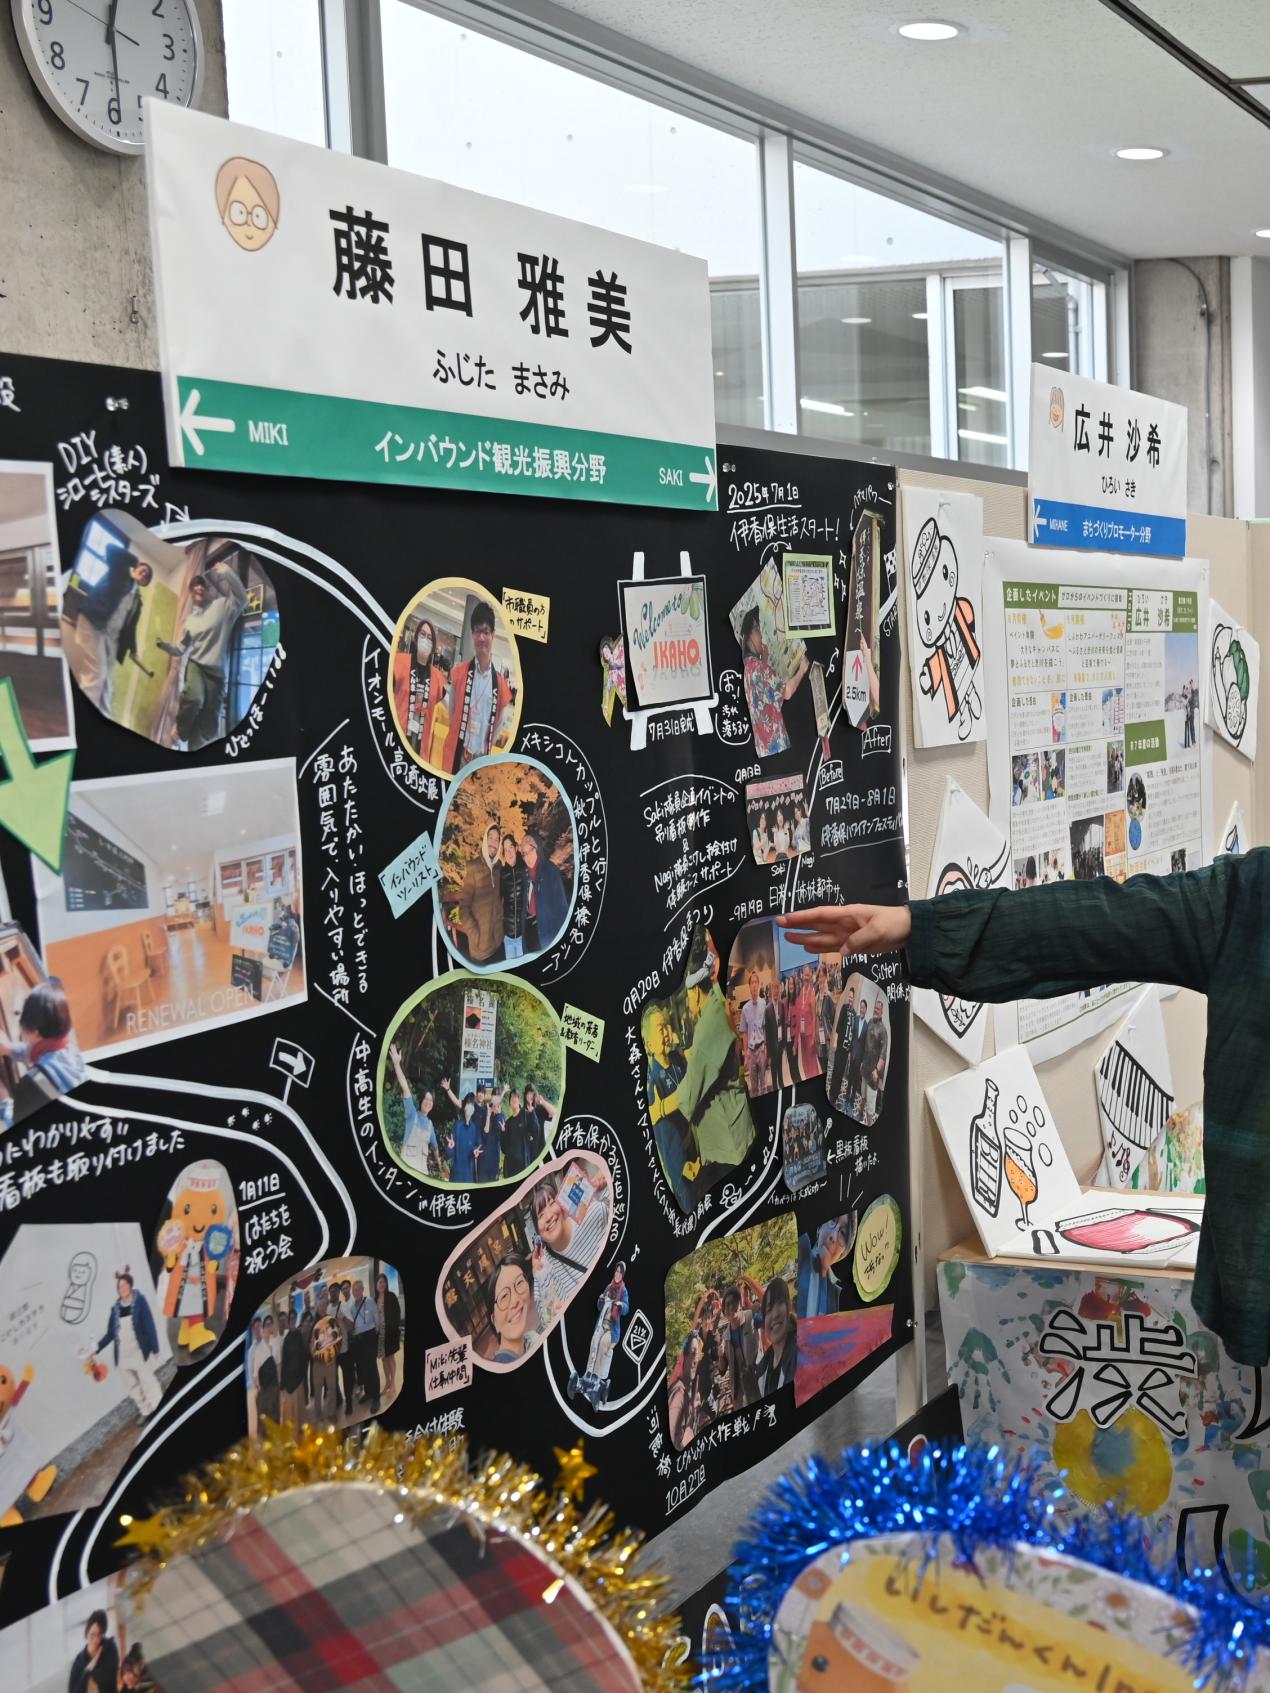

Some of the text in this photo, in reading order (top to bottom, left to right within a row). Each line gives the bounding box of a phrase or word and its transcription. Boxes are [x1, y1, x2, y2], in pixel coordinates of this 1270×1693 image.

[50, 41, 65, 70] 8
[162, 34, 175, 61] 3
[76, 78, 89, 105] 7
[155, 72, 169, 99] 4
[107, 97, 121, 124] 6
[329, 205, 632, 354] 藤田 雅美
[433, 349, 570, 400] ふじた まさみ
[248, 420, 289, 446] MIKI
[1073, 403, 1162, 469] 広井 沙希
[57, 430, 99, 474] DIY
[374, 430, 606, 484] インバウンド観光振興分野
[658, 467, 684, 486] SAKI
[1101, 475, 1137, 499] ひろい さき
[1082, 518, 1152, 545] まちづくりプロモーター分野
[1006, 587, 1057, 603] 企画したイベント
[632, 599, 673, 651] Welcome
[653, 637, 701, 670] IKAHO
[863, 727, 890, 748] After
[821, 764, 843, 785] Before
[871, 961, 899, 983] Sister
[126, 983, 254, 1035] RENEWAL OPEN
[0, 1115, 130, 1168] たわかりやすい
[238, 1172, 281, 1201] 1月11日
[244, 1233, 294, 1275] 祝う会
[665, 1464, 706, 1512] 10月27日
